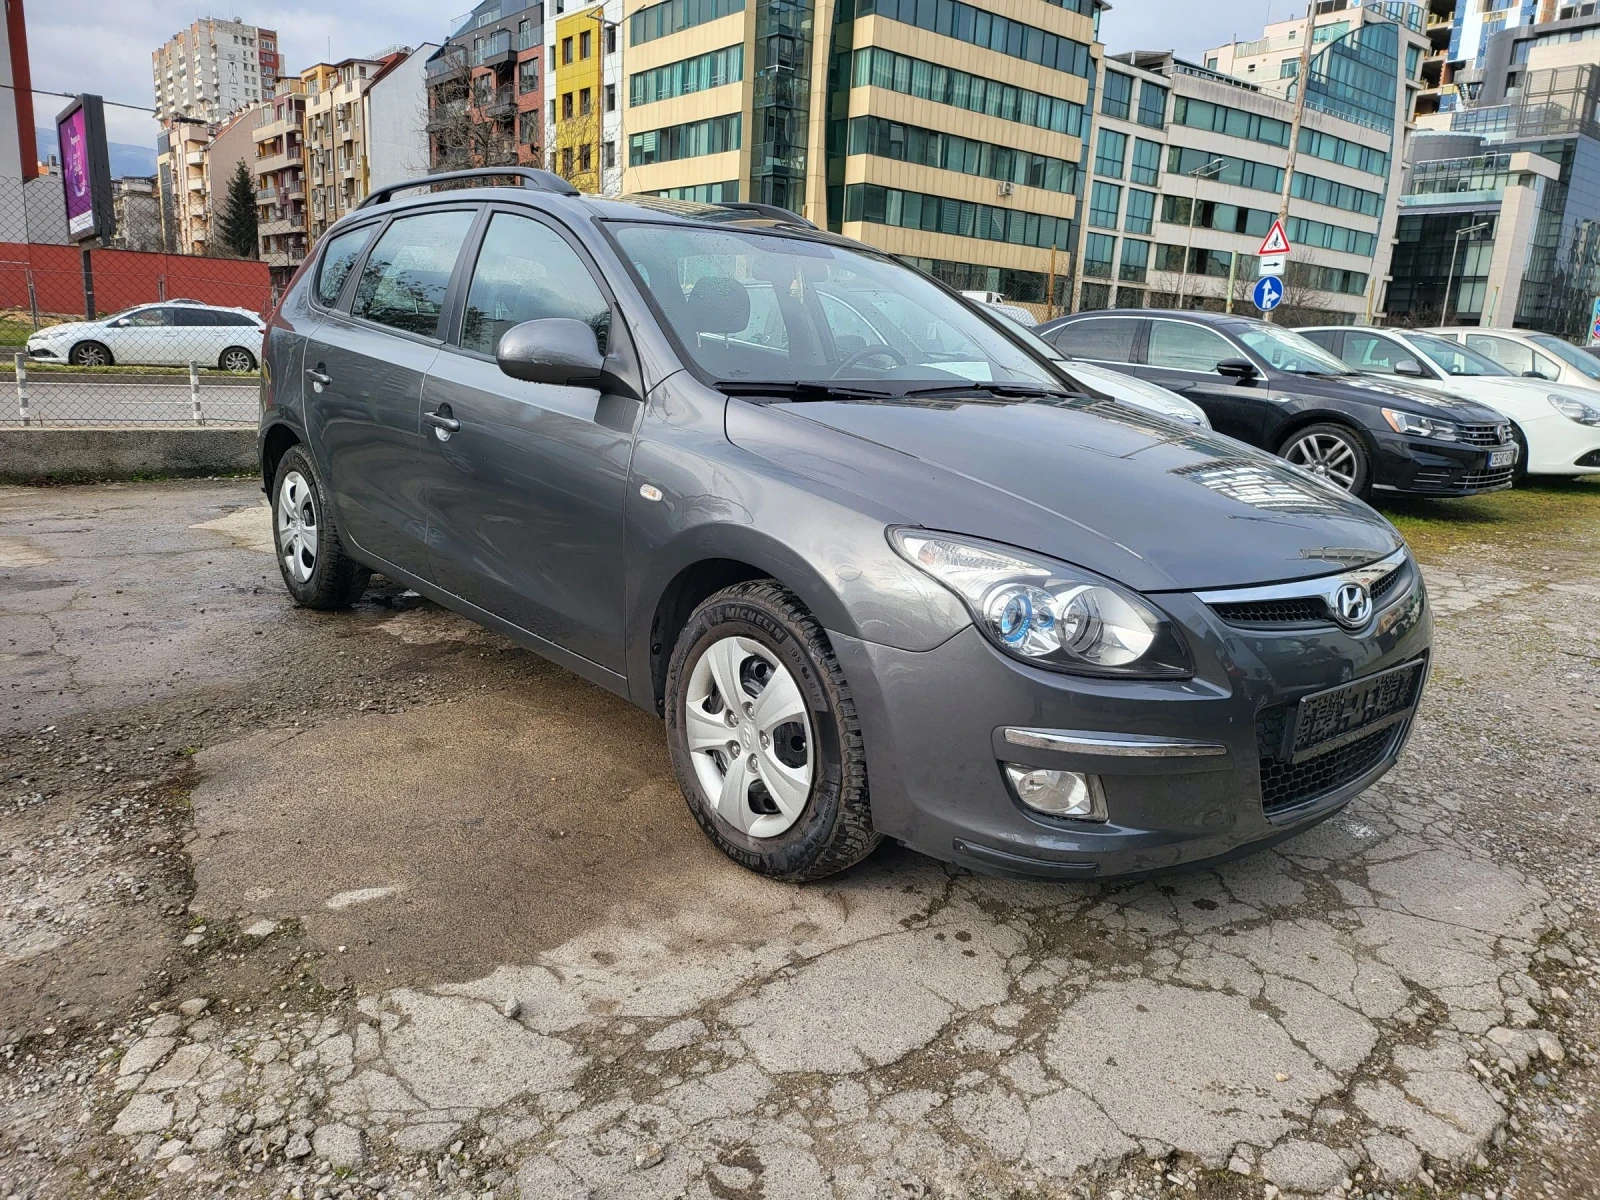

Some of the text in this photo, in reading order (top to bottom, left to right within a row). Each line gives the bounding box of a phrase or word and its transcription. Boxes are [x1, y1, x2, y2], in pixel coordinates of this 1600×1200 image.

[725, 607, 785, 640] MICHELIN
[790, 648, 811, 680] 195/65
[812, 693, 821, 704] 15
